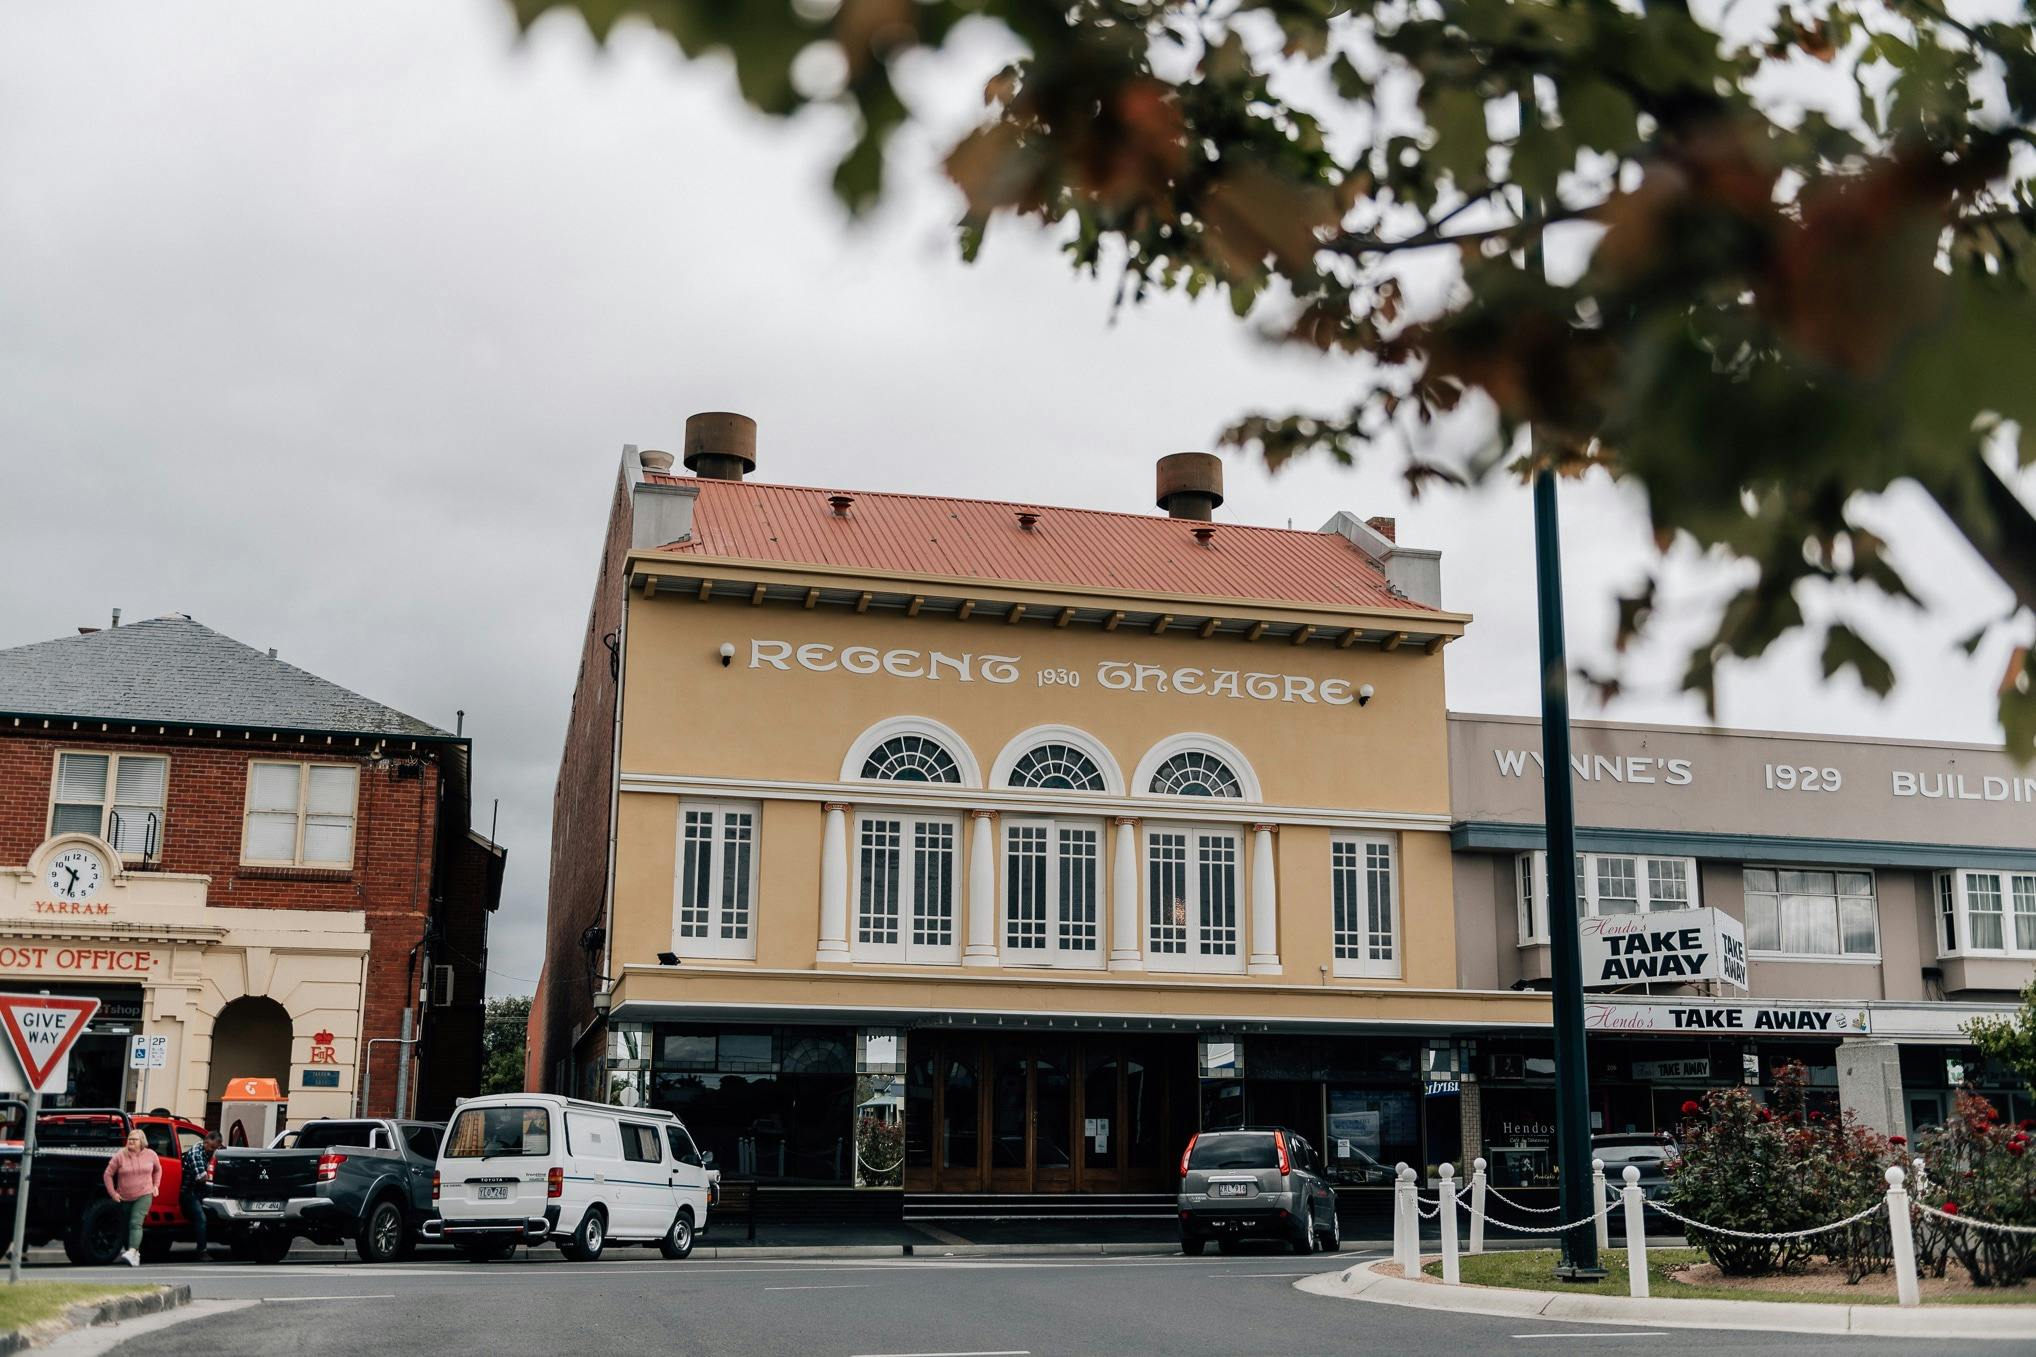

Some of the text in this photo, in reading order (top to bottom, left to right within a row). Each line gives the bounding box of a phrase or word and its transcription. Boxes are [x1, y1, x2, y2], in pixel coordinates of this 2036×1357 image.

[748, 638, 1354, 705] REGENT 1930 THEATRE
[1764, 763, 1842, 792] 1929
[55, 861, 64, 869] 10
[35, 901, 109, 915] YARRAM
[1579, 915, 1647, 936] Hendo's
[1602, 928, 1703, 956] TAKE
[1721, 932, 1744, 962] TAKE
[1600, 953, 1709, 981] AWAY
[1723, 955, 1746, 985] AWAY
[23, 1012, 66, 1029] GIVE
[1584, 1005, 1832, 1030] Hendo's TAKE AWAY
[29, 1031, 59, 1044] WAY
[138, 1037, 145, 1046] P
[152, 1037, 166, 1046] 2P
[1657, 1062, 1681, 1077] TAKE
[1683, 1061, 1708, 1076] AWAY
[1503, 1121, 1555, 1134] Hendos
